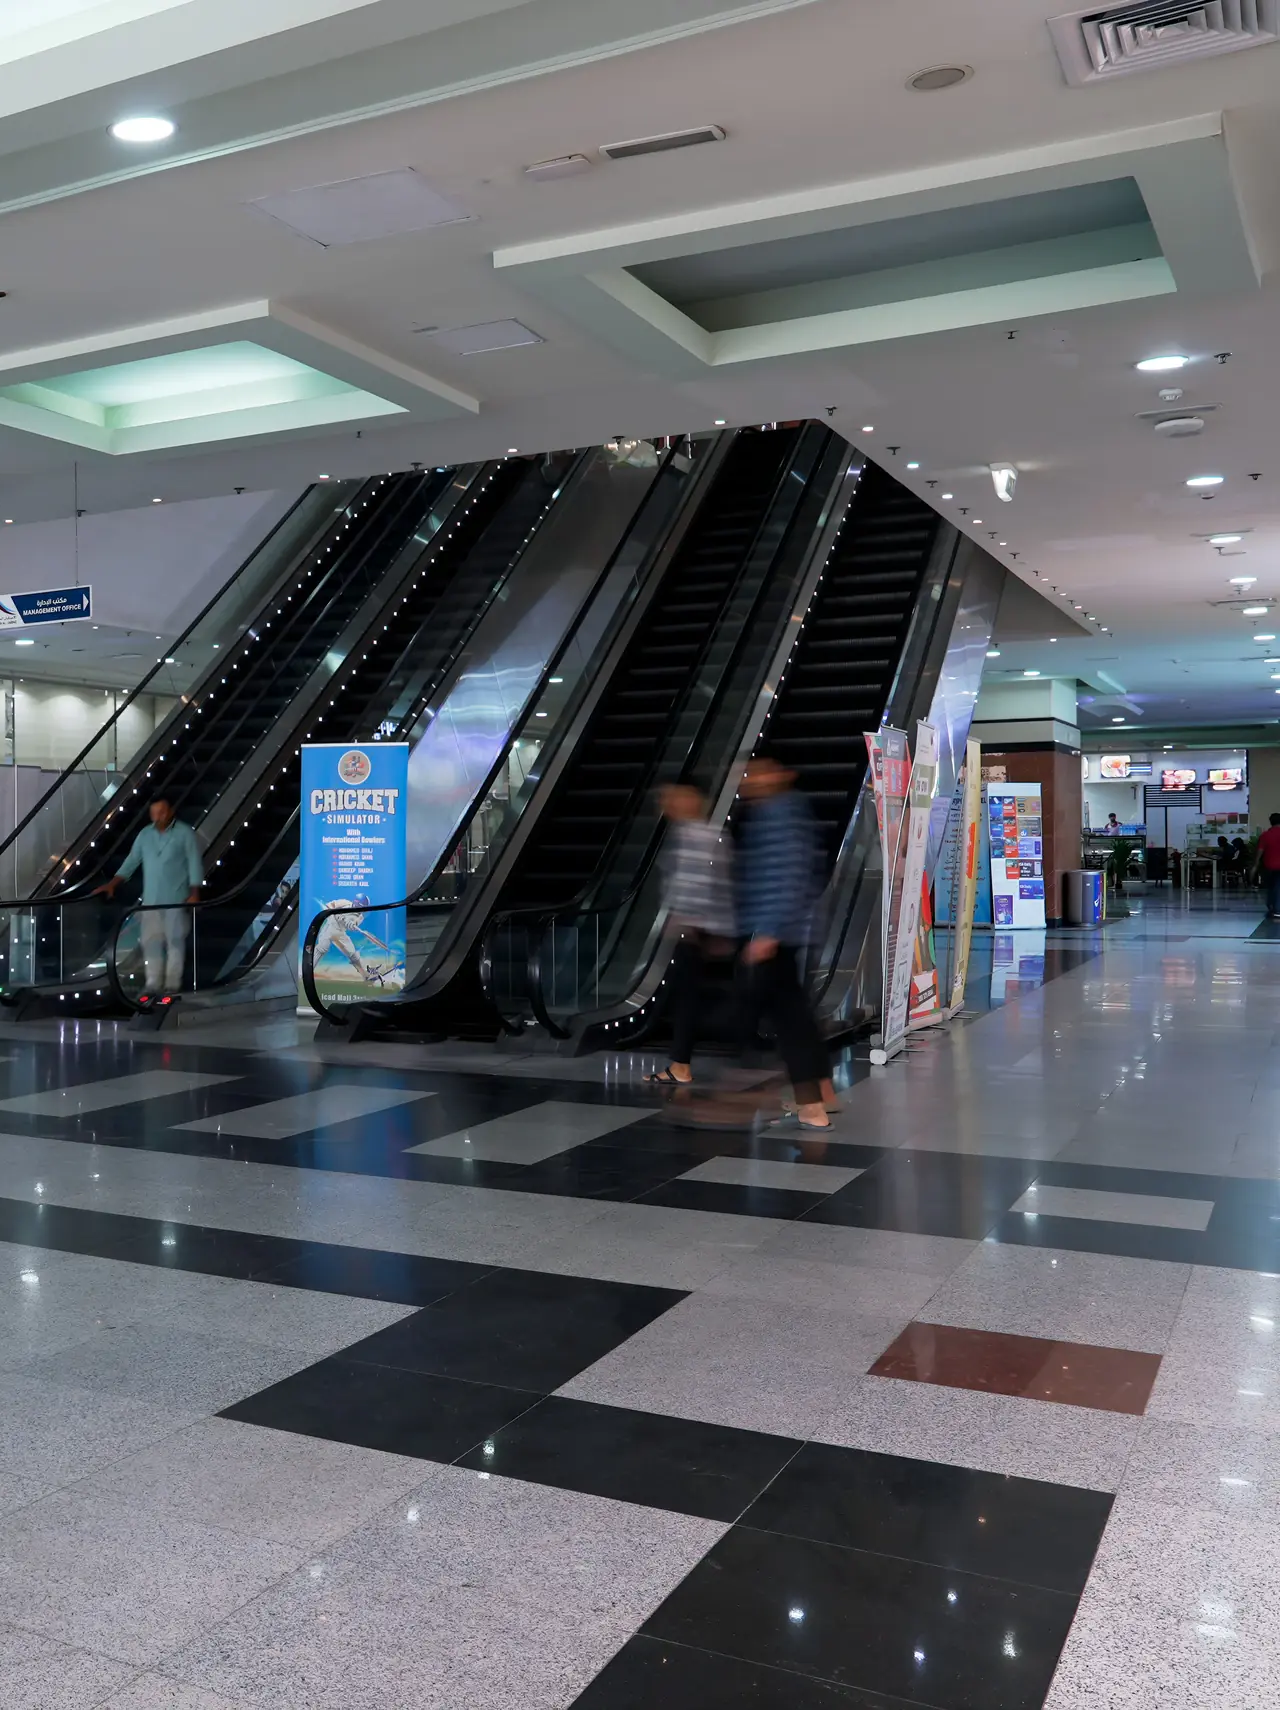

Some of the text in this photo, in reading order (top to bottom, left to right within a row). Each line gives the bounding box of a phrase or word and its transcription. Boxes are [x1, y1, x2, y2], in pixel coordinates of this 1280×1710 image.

[23, 604, 81, 616] MANAGEMENT OFFICE
[310, 789, 399, 815] CRICKET
[327, 814, 380, 825] SIMULATOR
